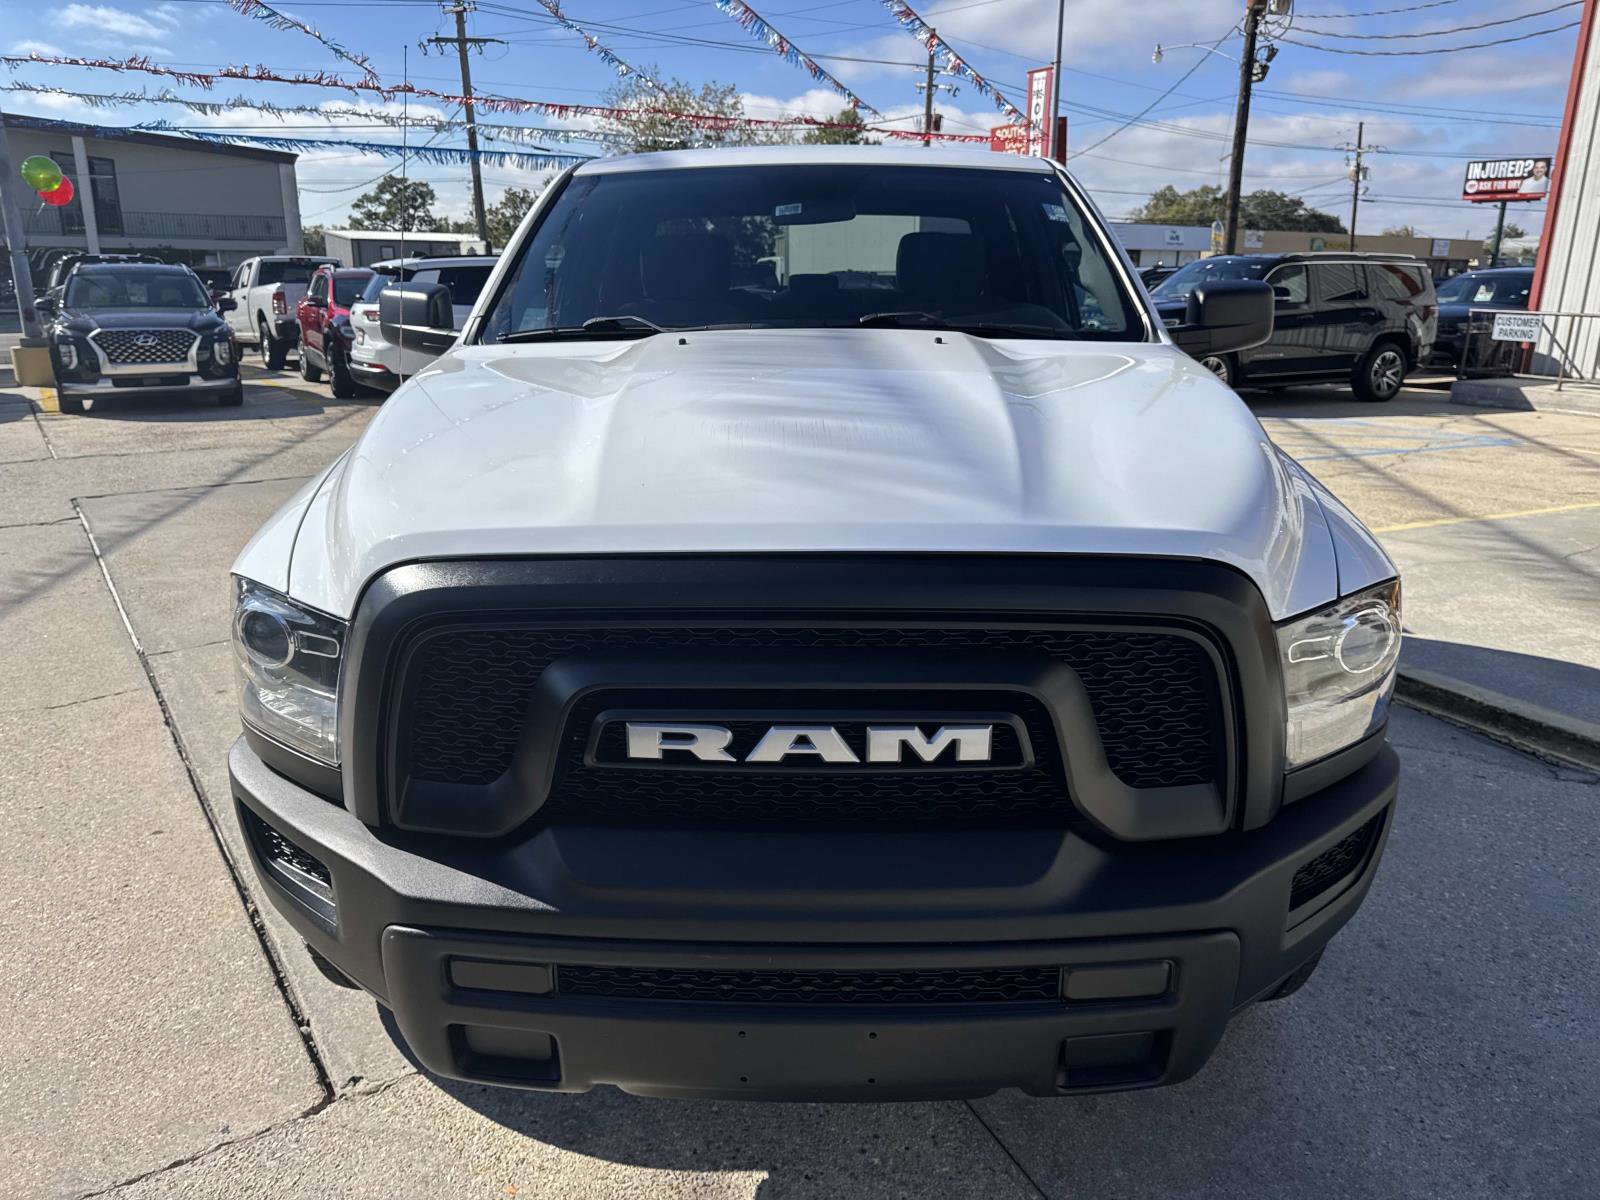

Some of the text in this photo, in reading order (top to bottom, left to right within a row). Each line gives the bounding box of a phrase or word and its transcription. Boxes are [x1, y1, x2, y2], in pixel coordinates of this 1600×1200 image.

[1468, 160, 1534, 179] INJURED?
[1497, 317, 1540, 328] CUSTOMER
[1499, 328, 1533, 339] PARKING
[625, 722, 993, 763] RAM
